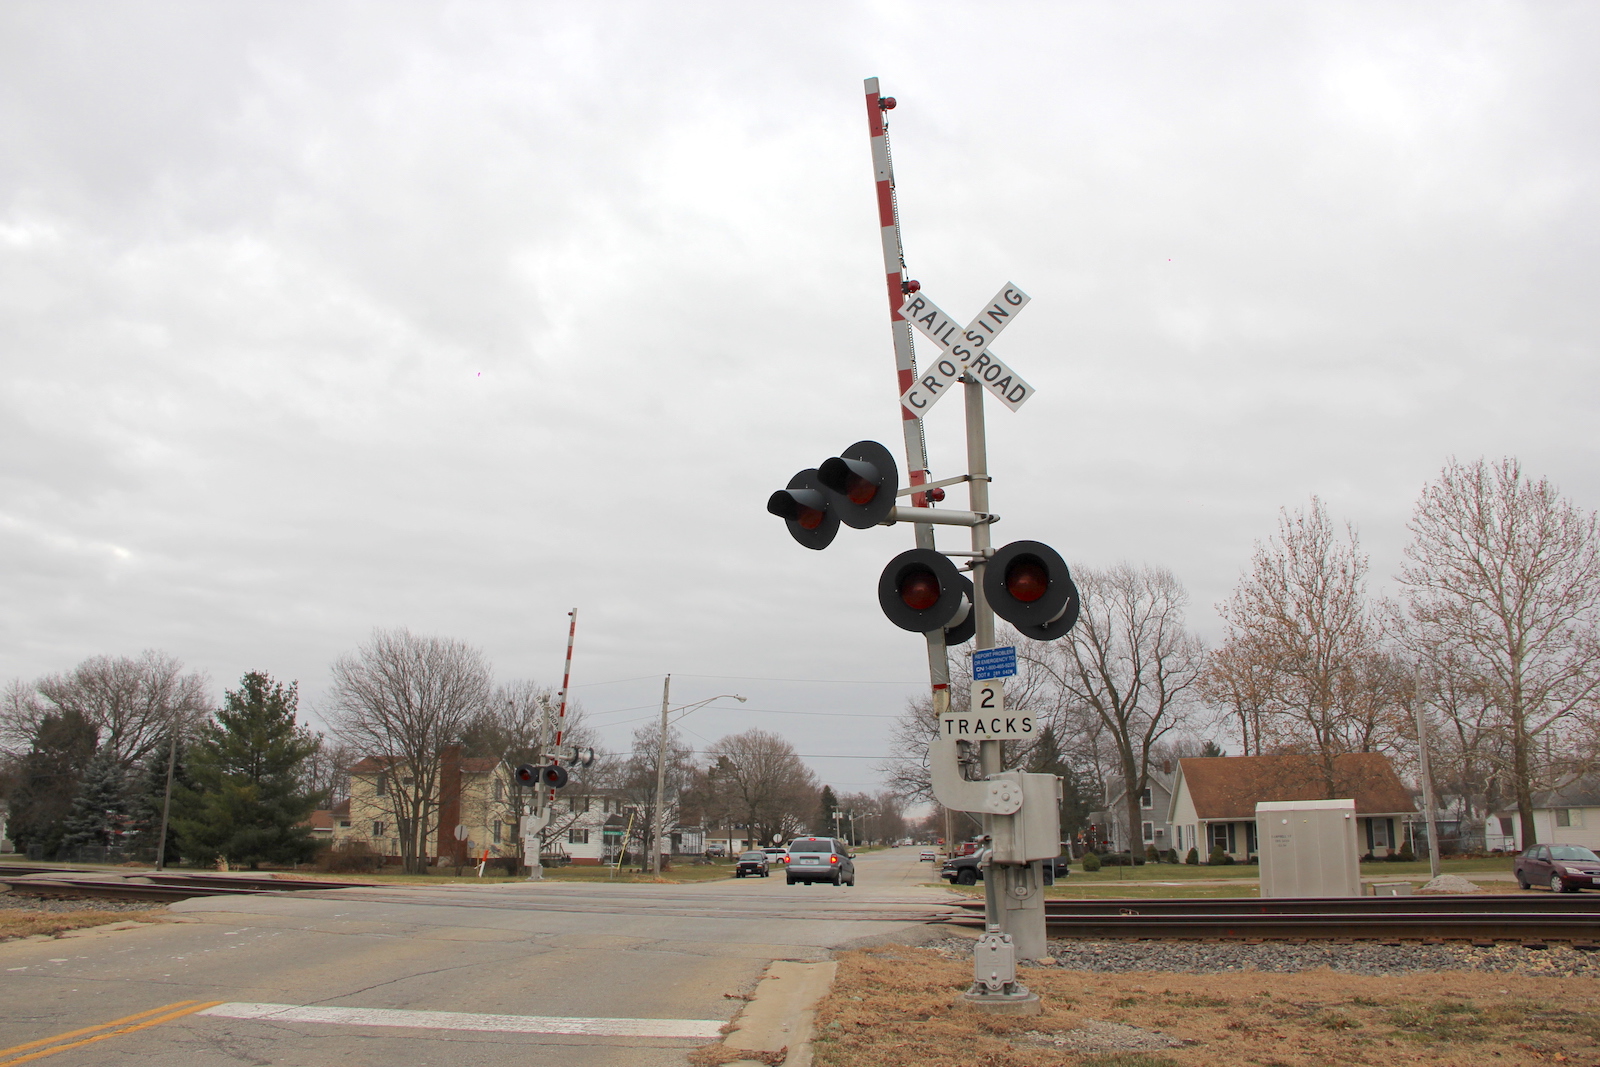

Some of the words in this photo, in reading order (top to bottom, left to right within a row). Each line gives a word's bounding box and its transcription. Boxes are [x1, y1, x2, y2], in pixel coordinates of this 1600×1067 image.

[906, 297, 955, 347] RAIL
[971, 352, 1026, 403] ROAD
[908, 289, 1023, 409] CROSSING
[981, 656, 1008, 665] EMERGENCY
[980, 688, 995, 709] 2
[944, 717, 1032, 735] TRACKS
